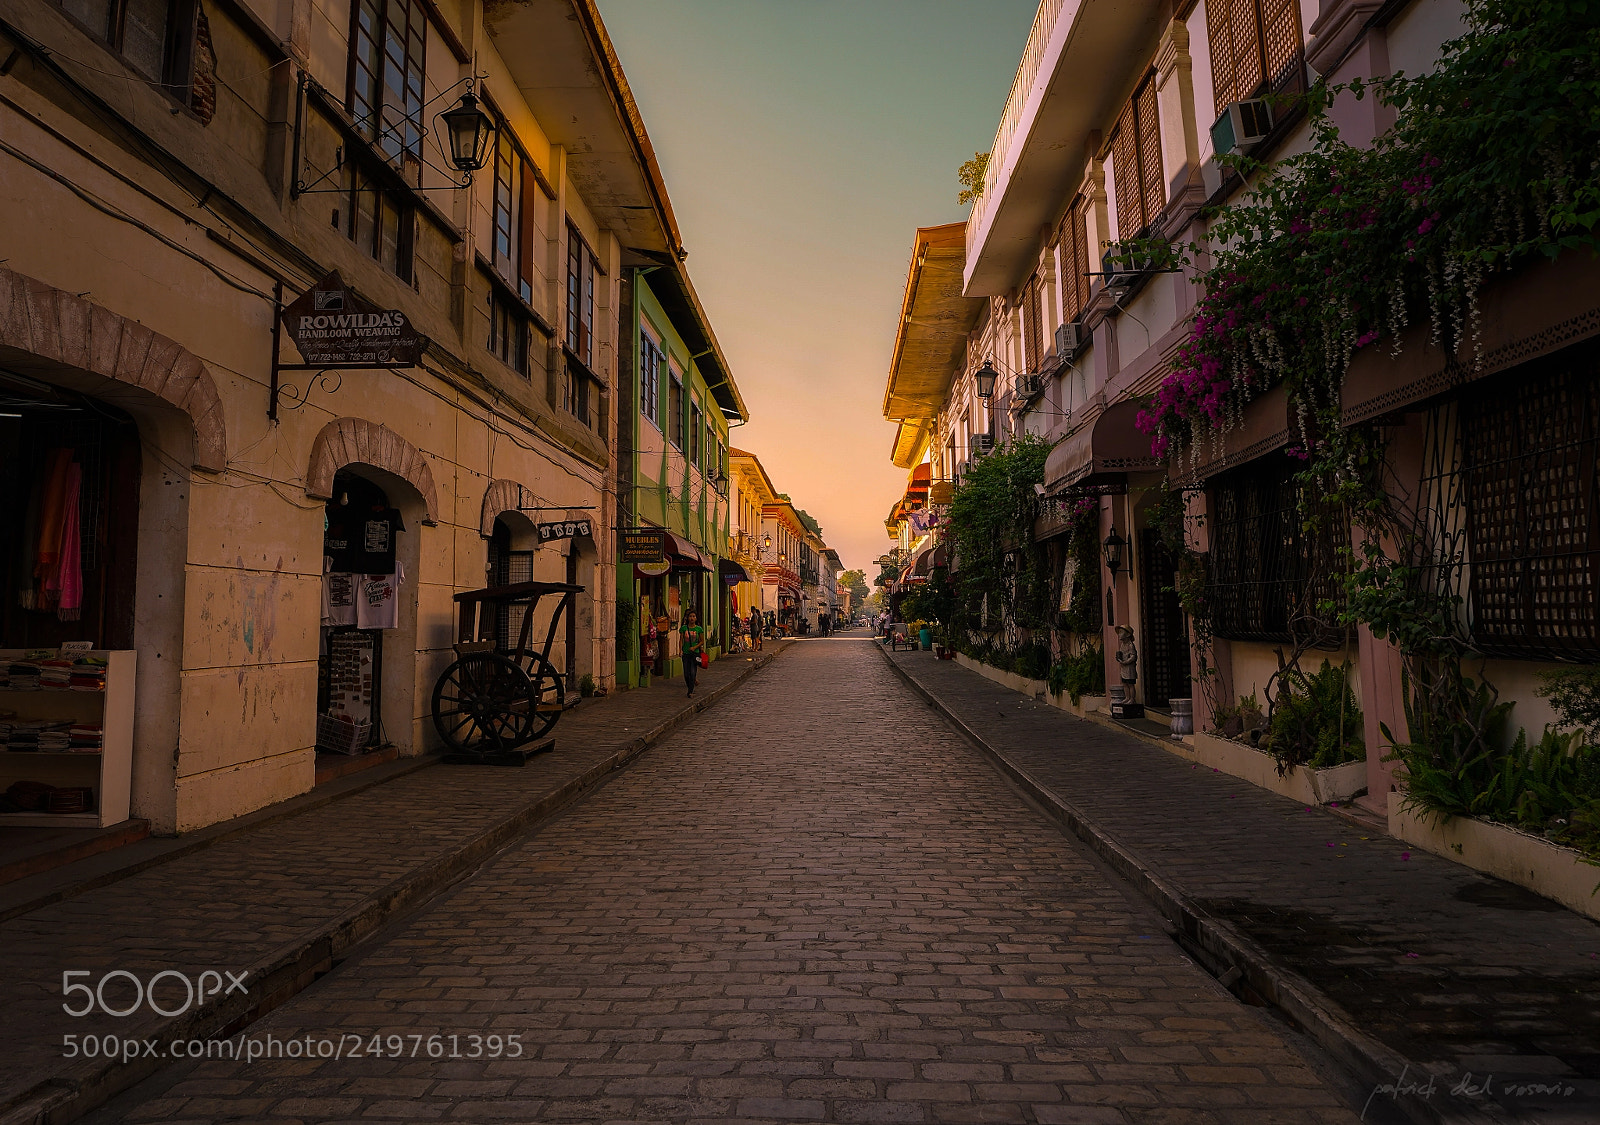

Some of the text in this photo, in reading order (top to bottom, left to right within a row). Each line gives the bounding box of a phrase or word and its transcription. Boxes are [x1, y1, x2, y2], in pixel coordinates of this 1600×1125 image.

[299, 312, 404, 329] ROWILDA'S
[298, 327, 401, 339] HANDLOOM WEAVING
[625, 536, 660, 544] MUEBLES
